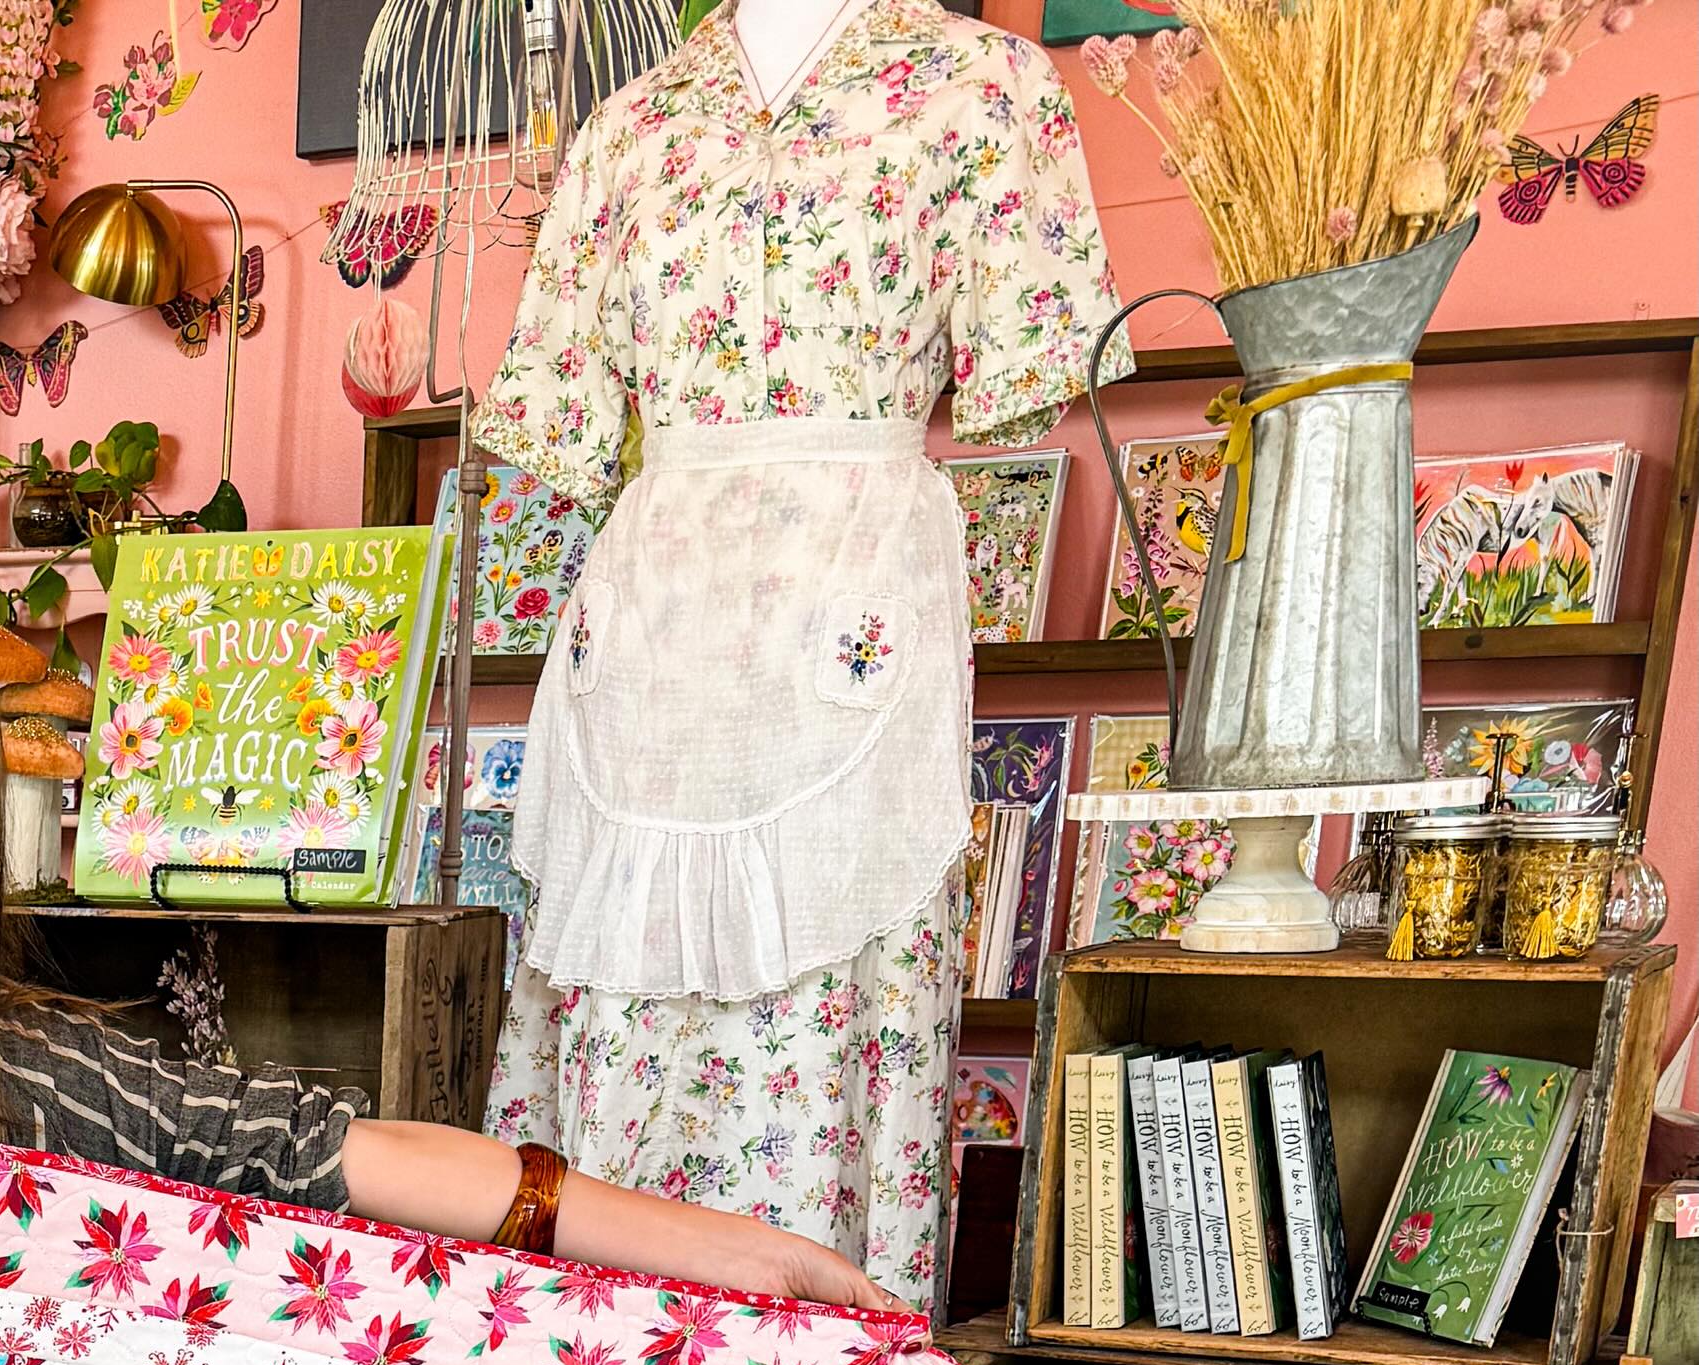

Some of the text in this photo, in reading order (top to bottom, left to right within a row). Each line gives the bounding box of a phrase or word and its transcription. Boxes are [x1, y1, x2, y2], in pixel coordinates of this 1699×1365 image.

[140, 538, 406, 583] KATIE DAISY
[188, 617, 328, 675] TRUST
[215, 669, 283, 726] the
[162, 729, 308, 794] MAGIC
[310, 880, 357, 891] Calendar
[1222, 1115, 1248, 1162] HOW
[1421, 1121, 1536, 1177] HOW to be a
[1066, 1107, 1091, 1291] HOW to be a Wildflower
[1094, 1108, 1119, 1293] HOW to be a Wildflower
[1136, 1109, 1175, 1290] HOW to be a Moonflower
[1234, 1166, 1246, 1179] to
[1236, 1181, 1251, 1194] be
[1407, 1161, 1535, 1216] Wildflower
[1161, 1112, 1200, 1294] HOW to be a Moonflower
[1192, 1115, 1231, 1299] HOW to be a Moonflower
[1279, 1116, 1319, 1303] HOW to be a Moonflower
[1447, 1219, 1475, 1249] field
[1476, 1213, 1504, 1241] guide
[1236, 1209, 1263, 1300] Wildflower
[1456, 1242, 1472, 1263] by
